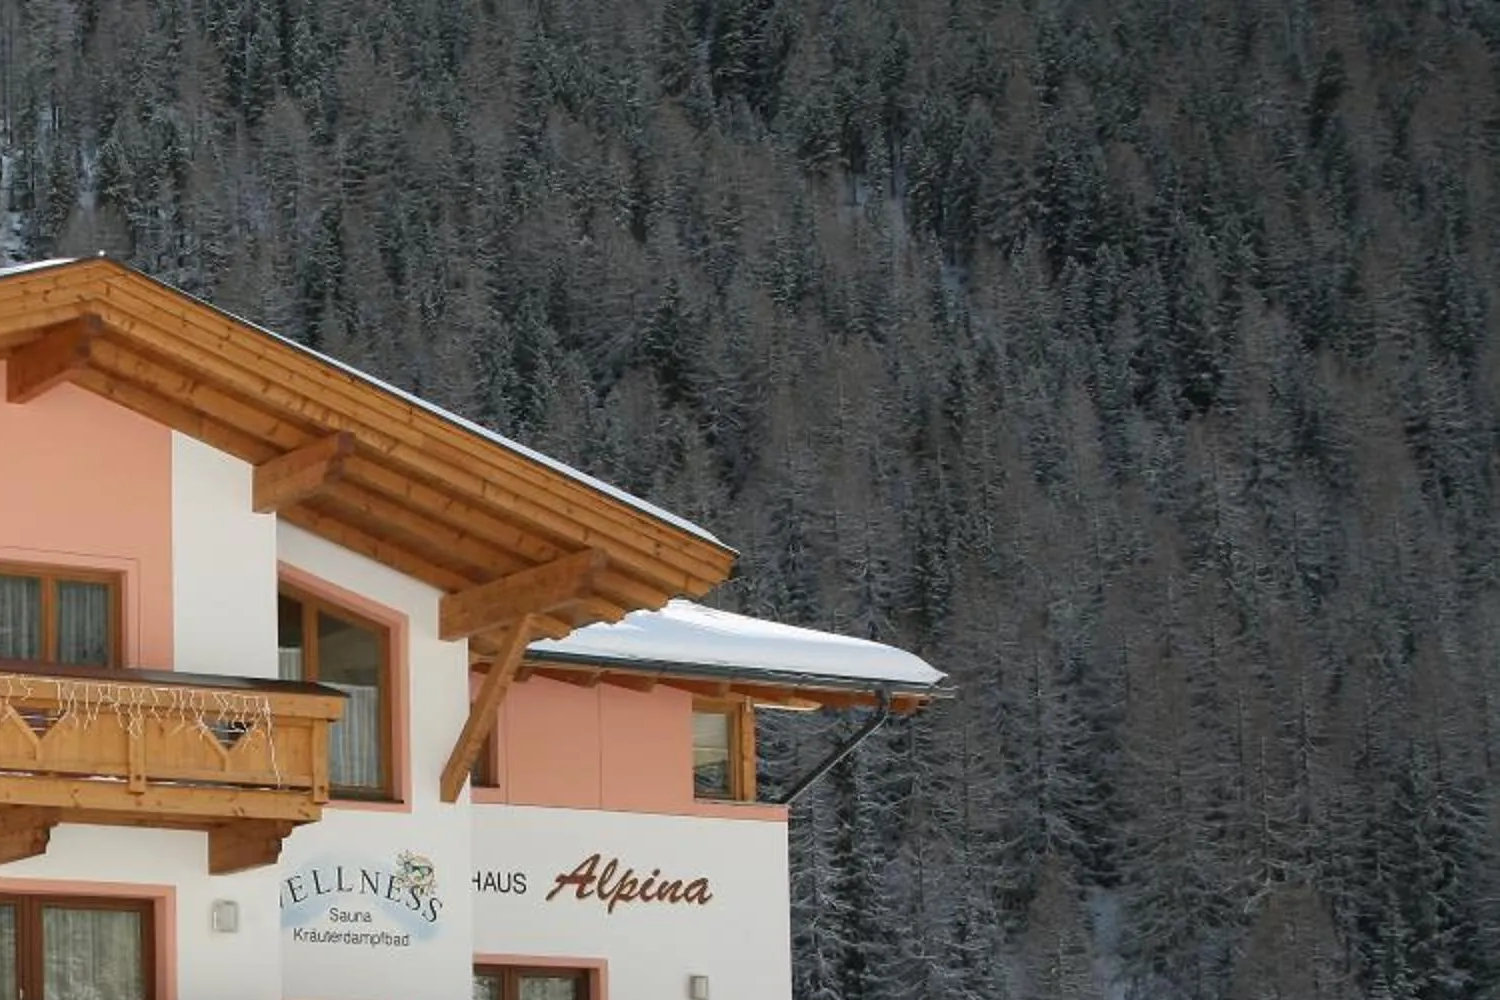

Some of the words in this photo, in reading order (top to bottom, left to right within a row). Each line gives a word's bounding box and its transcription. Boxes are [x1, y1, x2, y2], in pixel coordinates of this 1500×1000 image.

[280, 866, 443, 923] ELLNESS
[545, 853, 713, 914] Alpina
[329, 907, 373, 924] Sauna
[293, 927, 411, 948] Kräuterdampfbad
